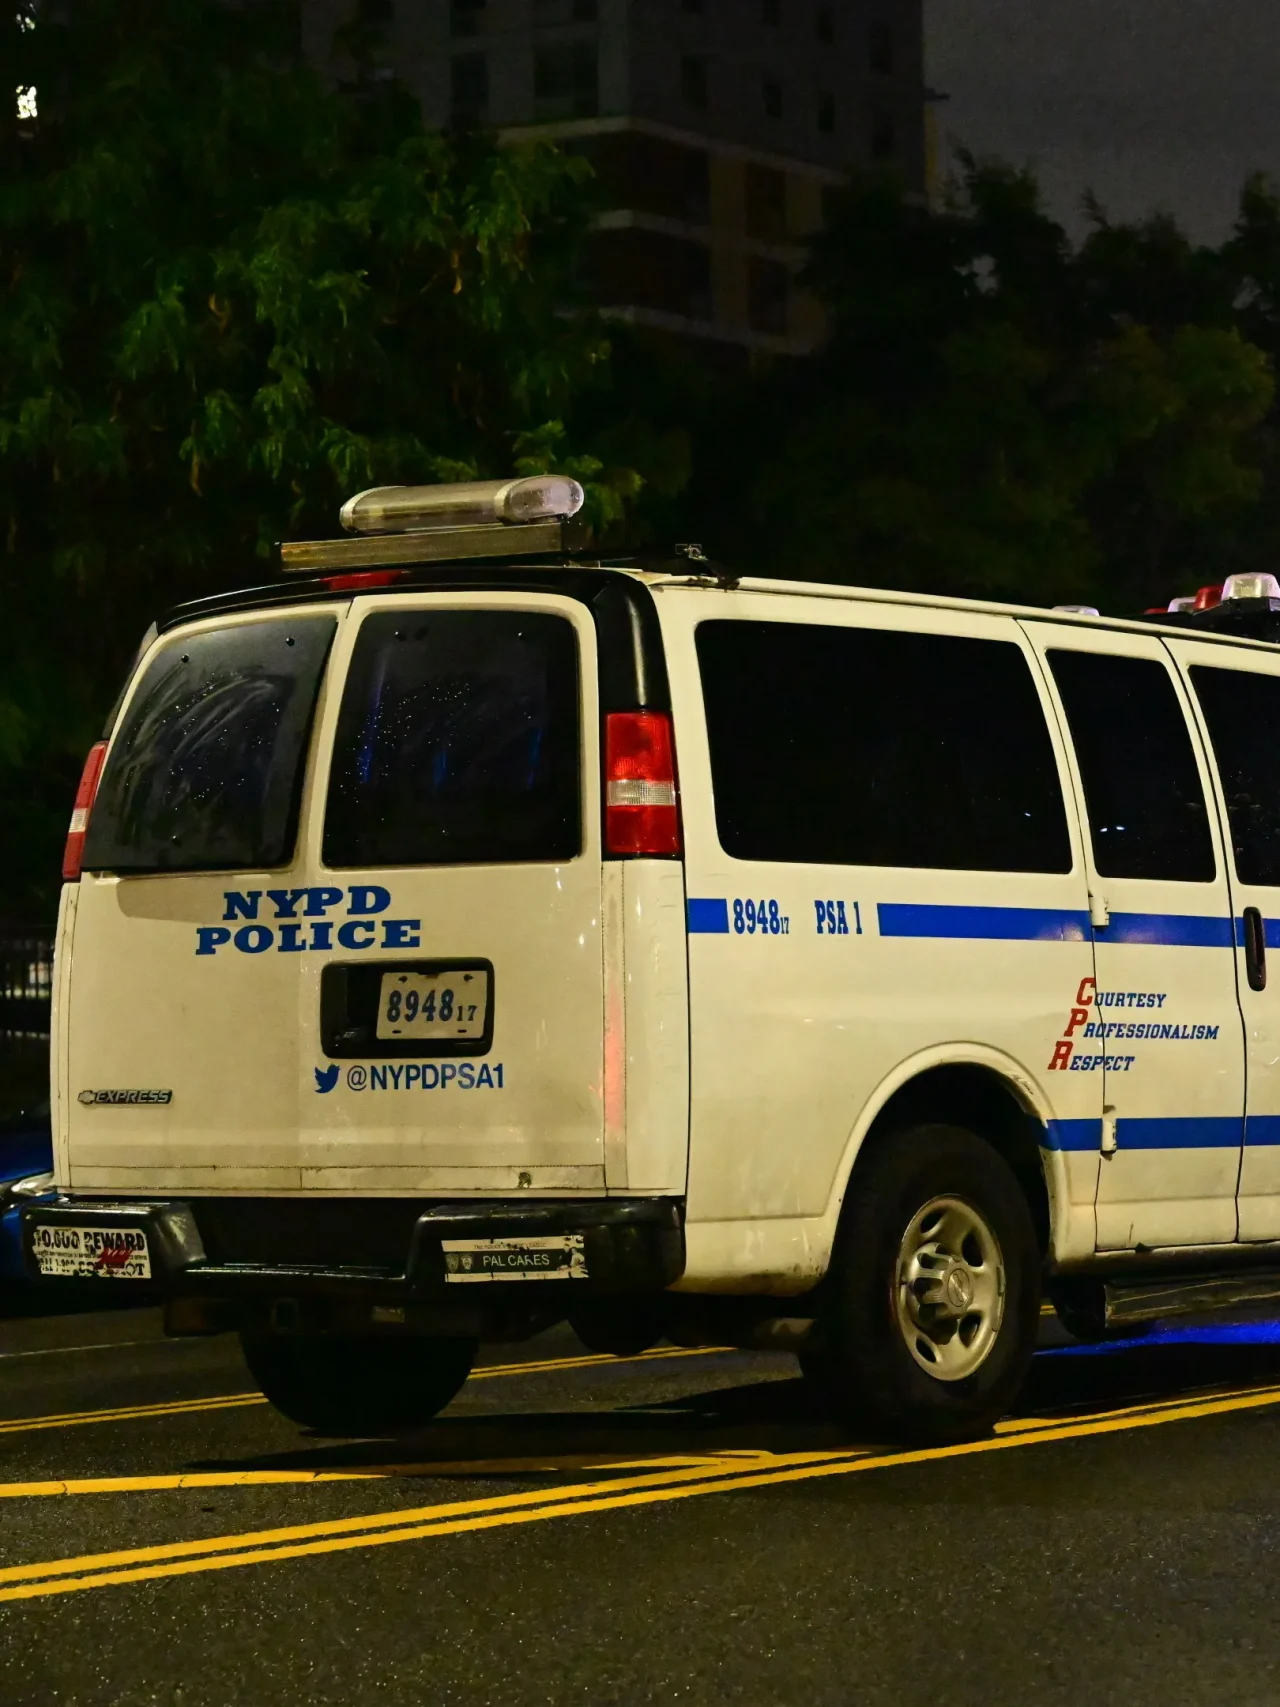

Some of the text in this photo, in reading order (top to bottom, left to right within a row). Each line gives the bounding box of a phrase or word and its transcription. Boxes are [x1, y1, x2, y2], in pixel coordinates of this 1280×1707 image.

[222, 885, 392, 921] NYPD
[814, 899, 863, 934] PSA 1
[195, 919, 421, 955] POLICE
[347, 1063, 504, 1091] @NYPDPSA1
[95, 1090, 170, 1103] EXPRESS
[483, 1253, 550, 1267] PAL CARES
